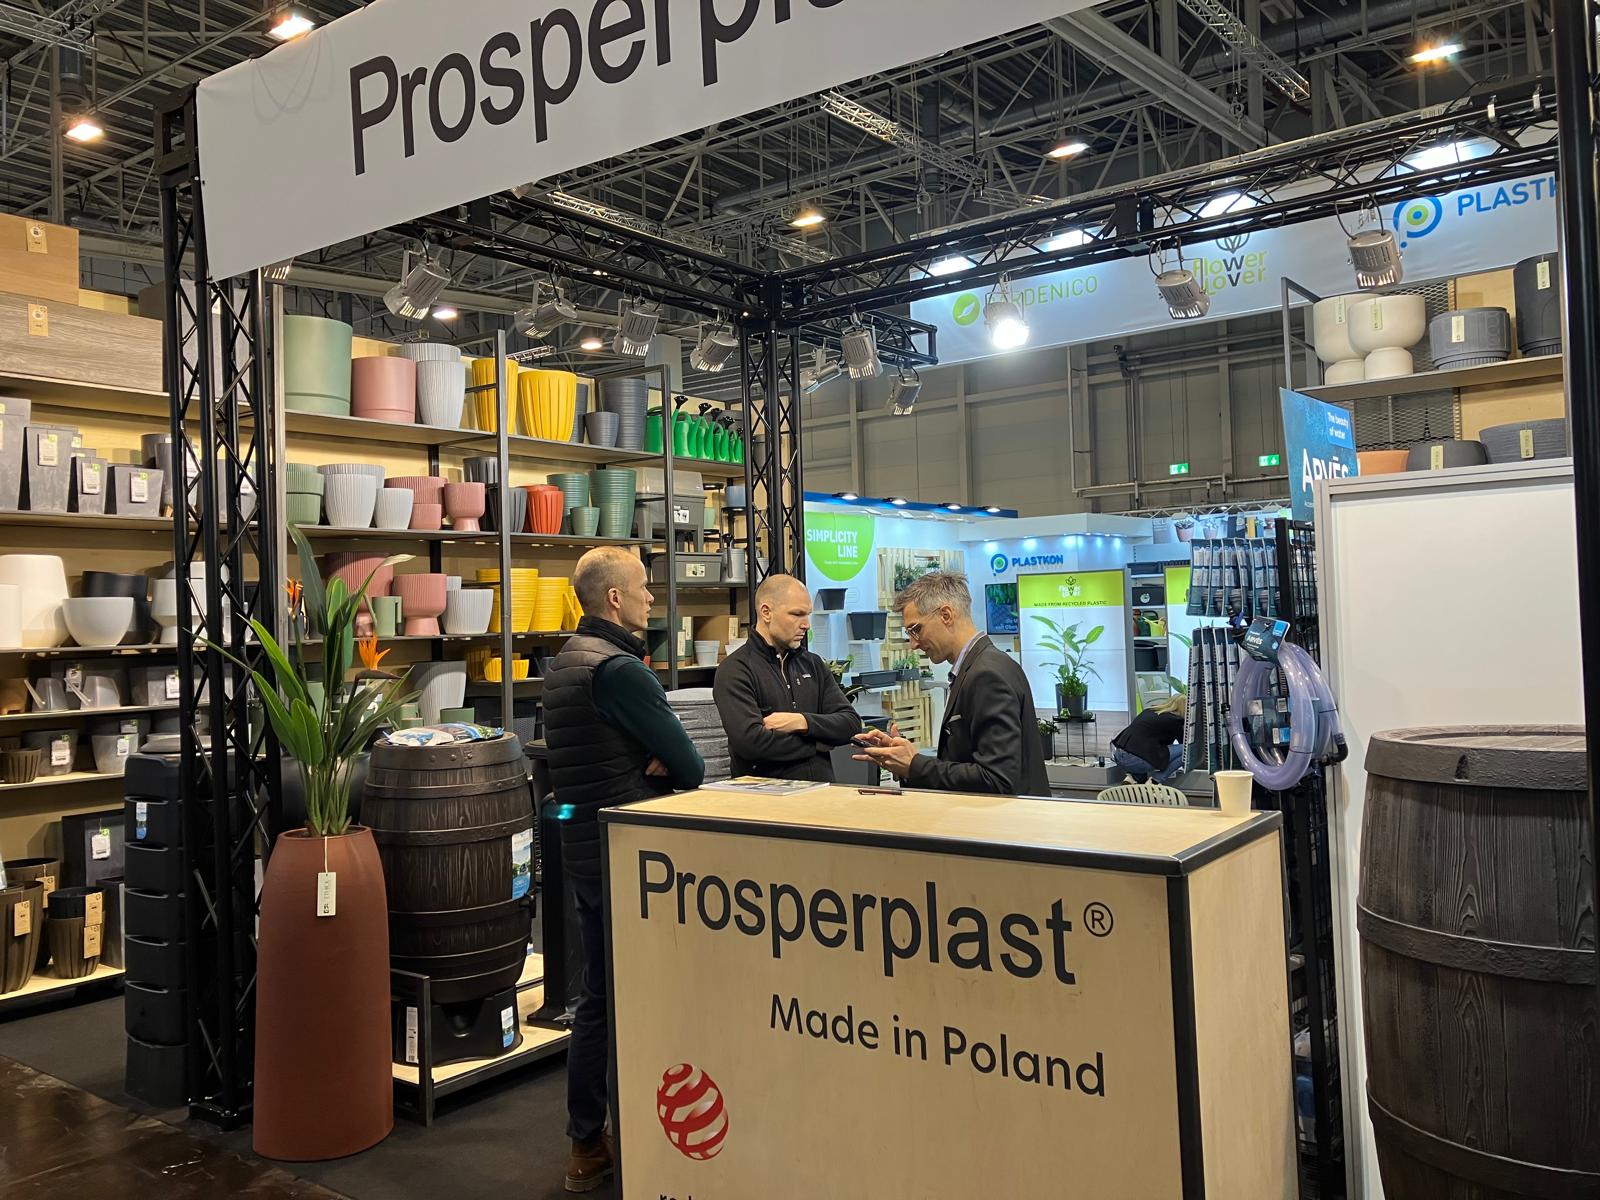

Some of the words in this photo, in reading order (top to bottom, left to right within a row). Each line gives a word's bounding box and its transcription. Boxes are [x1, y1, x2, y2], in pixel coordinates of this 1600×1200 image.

[350, 0, 846, 176] Prosperp
[806, 529, 858, 544] SIMPLICITY
[837, 545, 858, 558] LINE
[1011, 554, 1064, 567] PLASTKON
[770, 994, 879, 1049] Made
[893, 1015, 927, 1061] in
[943, 1026, 1106, 1097] Poland
